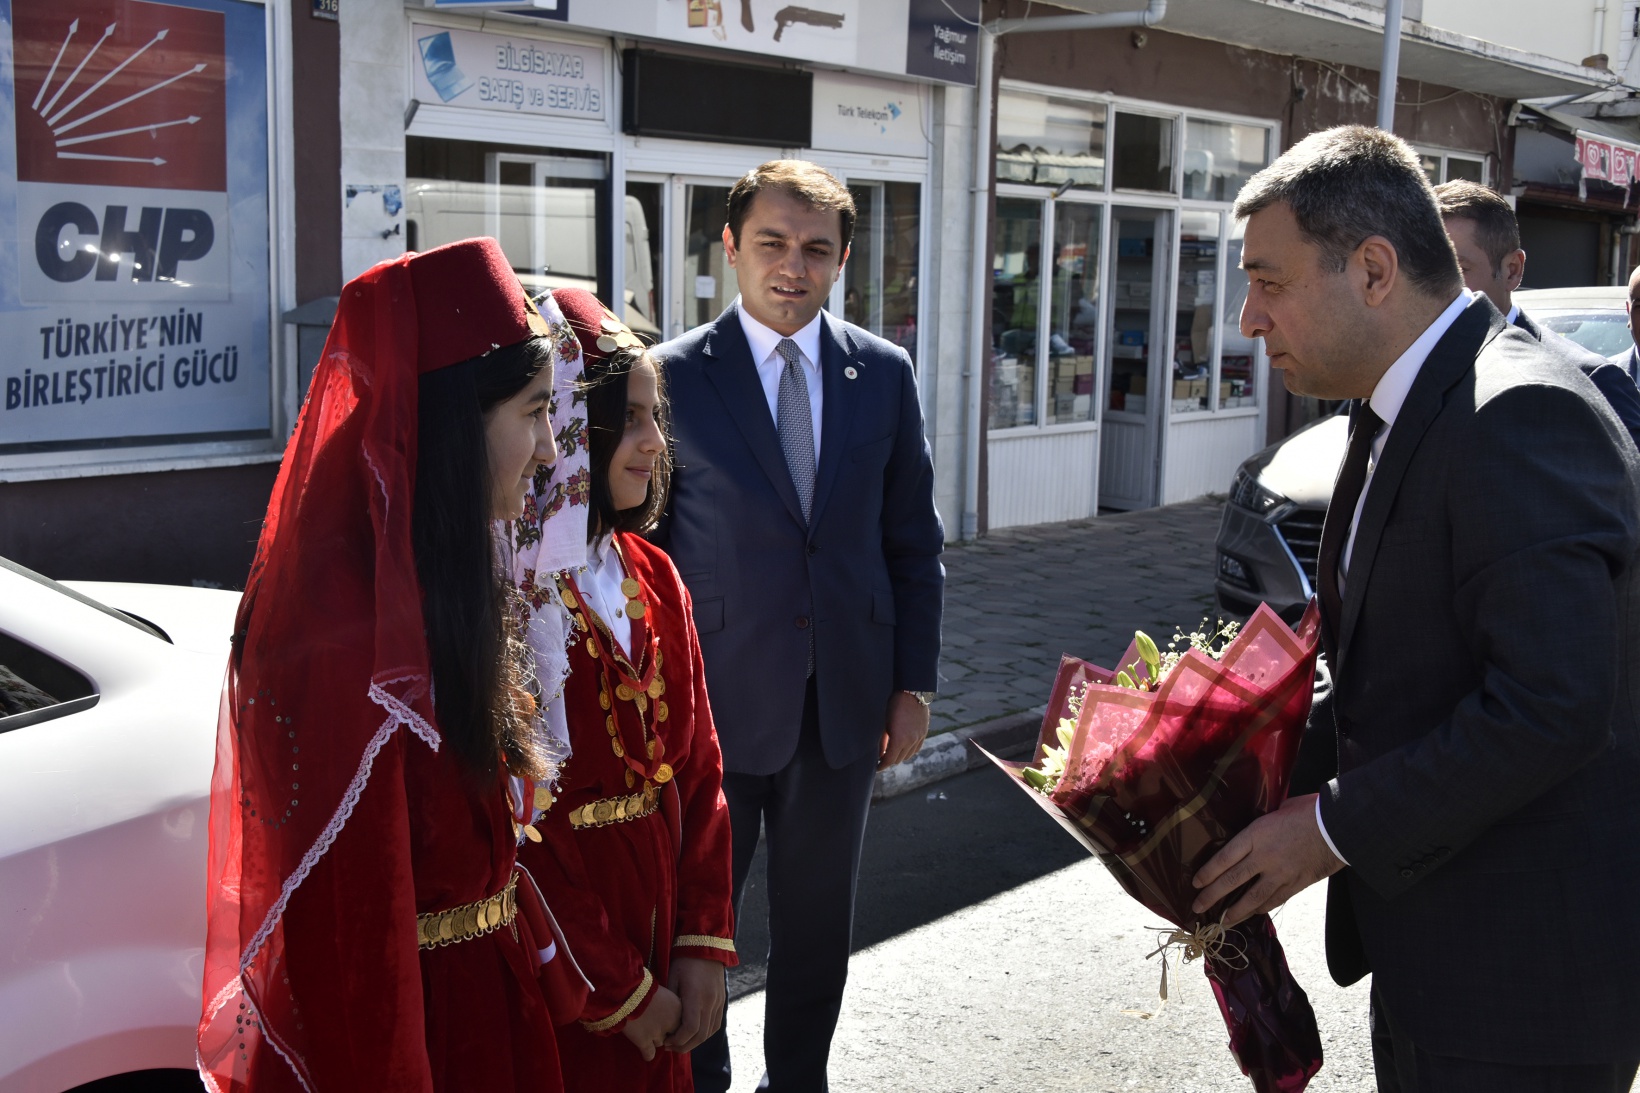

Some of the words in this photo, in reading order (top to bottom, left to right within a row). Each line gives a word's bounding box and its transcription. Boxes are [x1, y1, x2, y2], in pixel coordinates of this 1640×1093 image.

[320, 0, 338, 12] 316
[933, 24, 967, 44] Yağmur
[496, 41, 584, 79] BİLGİSAYAR
[933, 42, 966, 65] İletişim
[479, 76, 524, 109] SATIŞ
[527, 88, 544, 106] ve
[547, 83, 600, 112] SERVİS
[838, 104, 854, 118] Türk
[857, 106, 888, 121] Telekom
[35, 201, 215, 283] CHP
[40, 307, 203, 360] TÜRKİYE'NİN
[6, 353, 165, 411] BİRLEŞTİRİCİ
[173, 345, 239, 389] GÜCÜ
